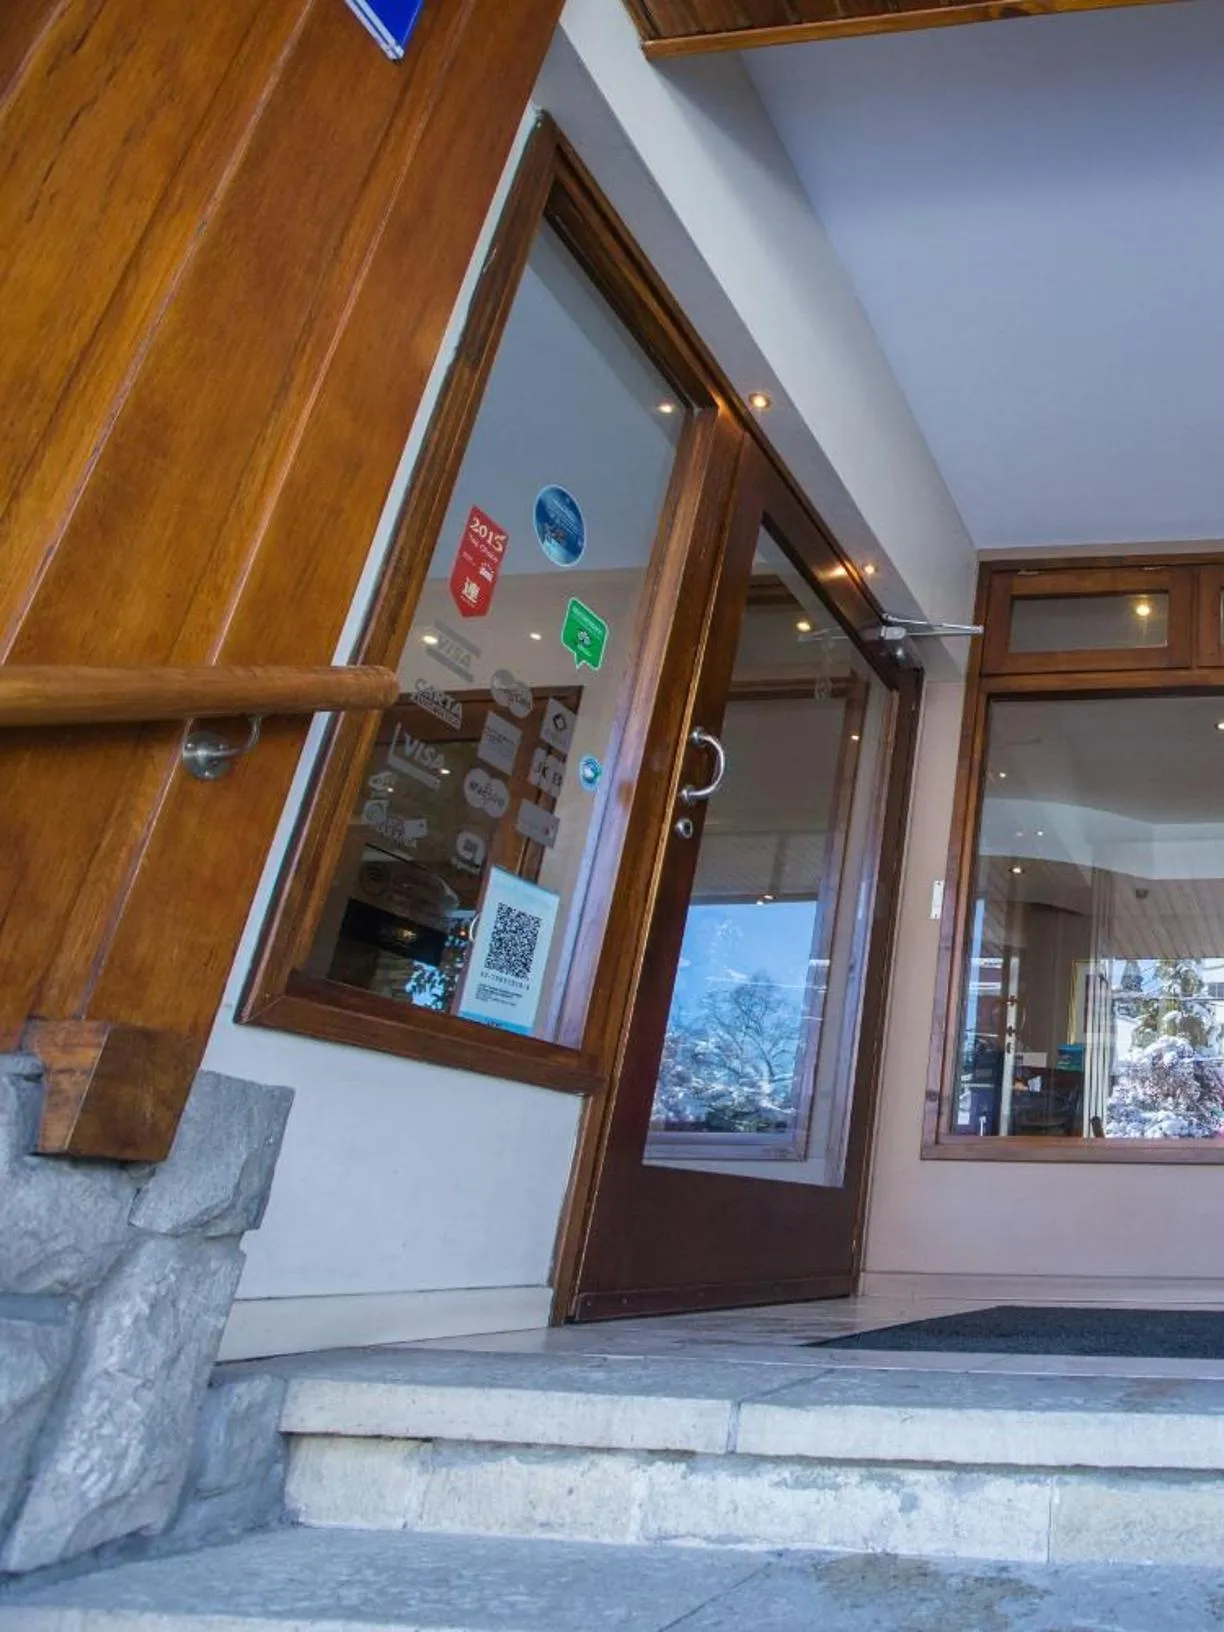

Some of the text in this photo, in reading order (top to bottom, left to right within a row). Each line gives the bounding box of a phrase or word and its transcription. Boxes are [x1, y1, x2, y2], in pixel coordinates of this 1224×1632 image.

[469, 516, 506, 552] 2015
[438, 634, 471, 668] VISA
[403, 731, 446, 769] VISA
